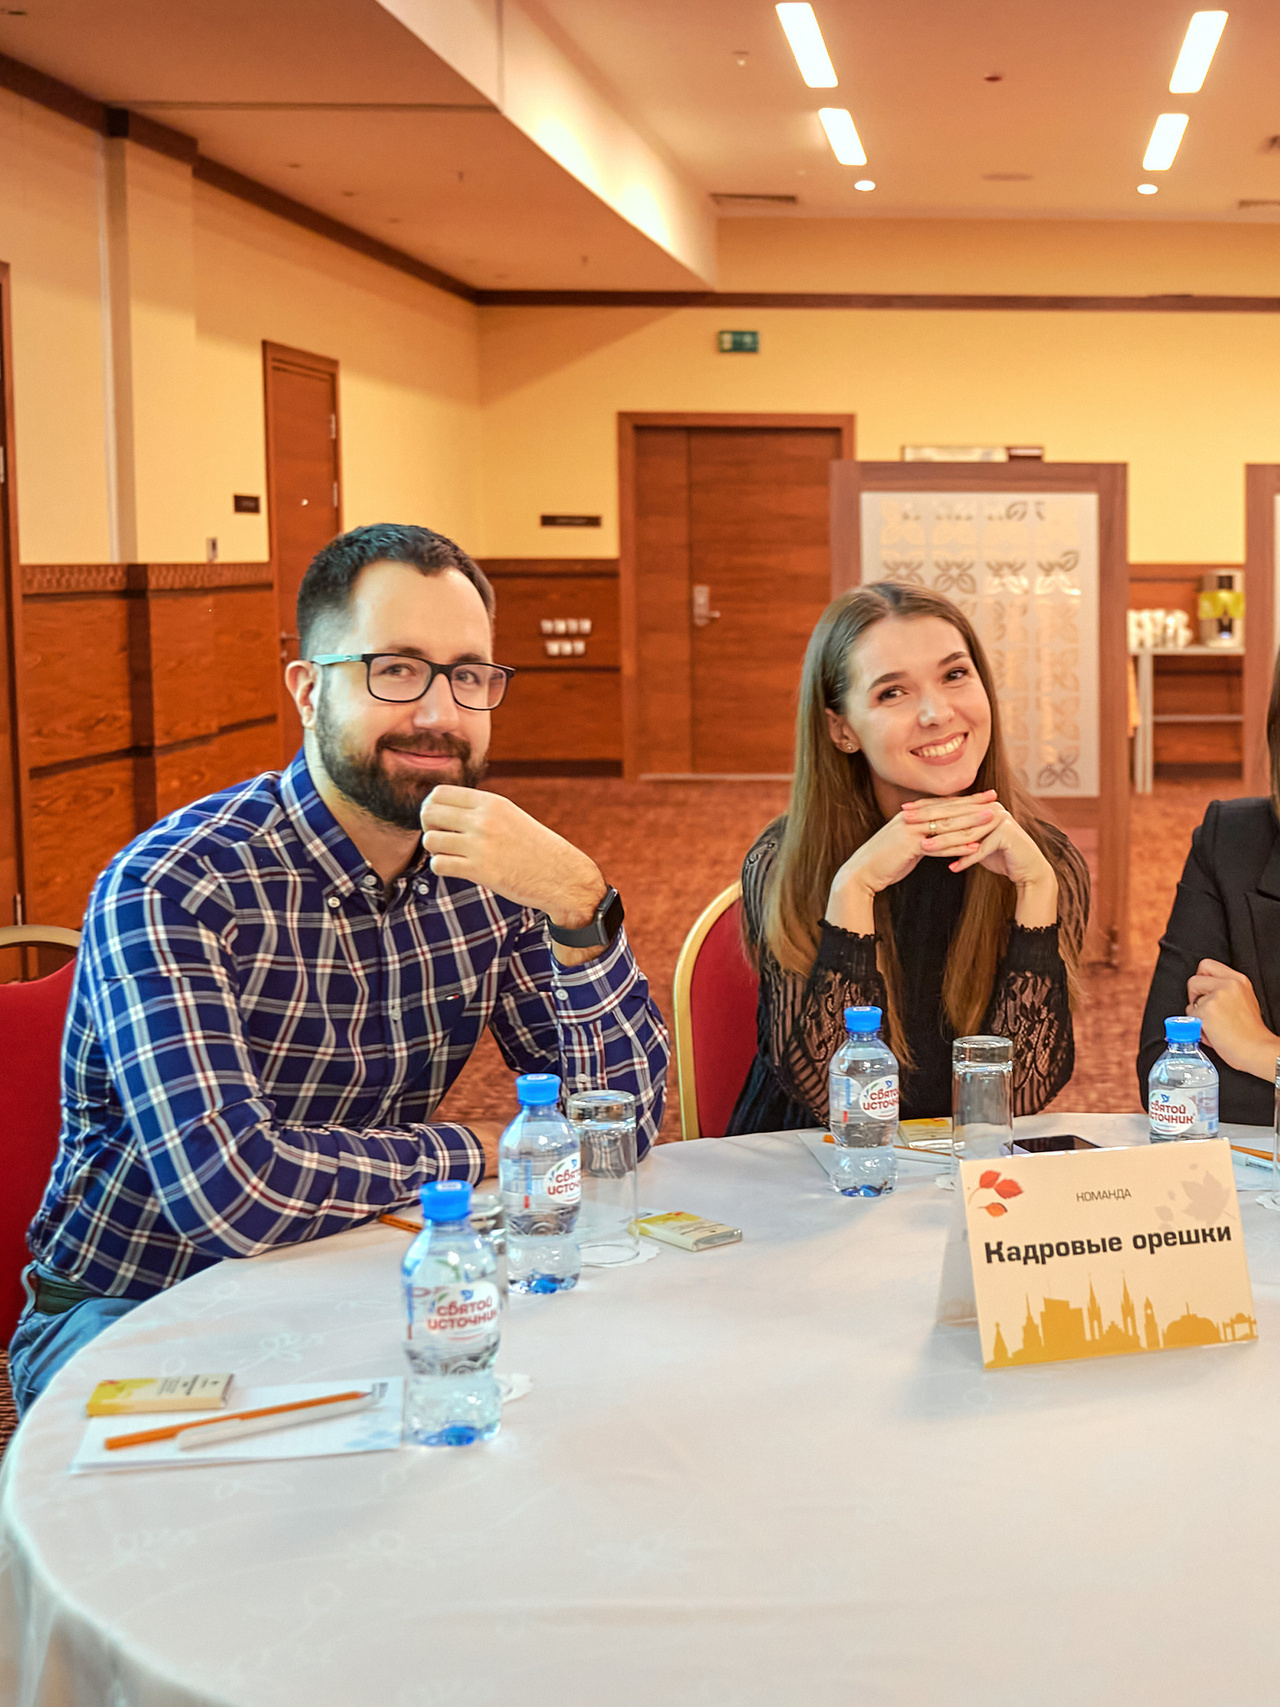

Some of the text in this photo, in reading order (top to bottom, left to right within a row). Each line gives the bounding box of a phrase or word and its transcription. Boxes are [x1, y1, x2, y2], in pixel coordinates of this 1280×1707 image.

[1150, 1110, 1194, 1125] сточник
[1076, 1188, 1132, 1203] КОМАНДА
[984, 1225, 1232, 1265] Кадровые орешки
